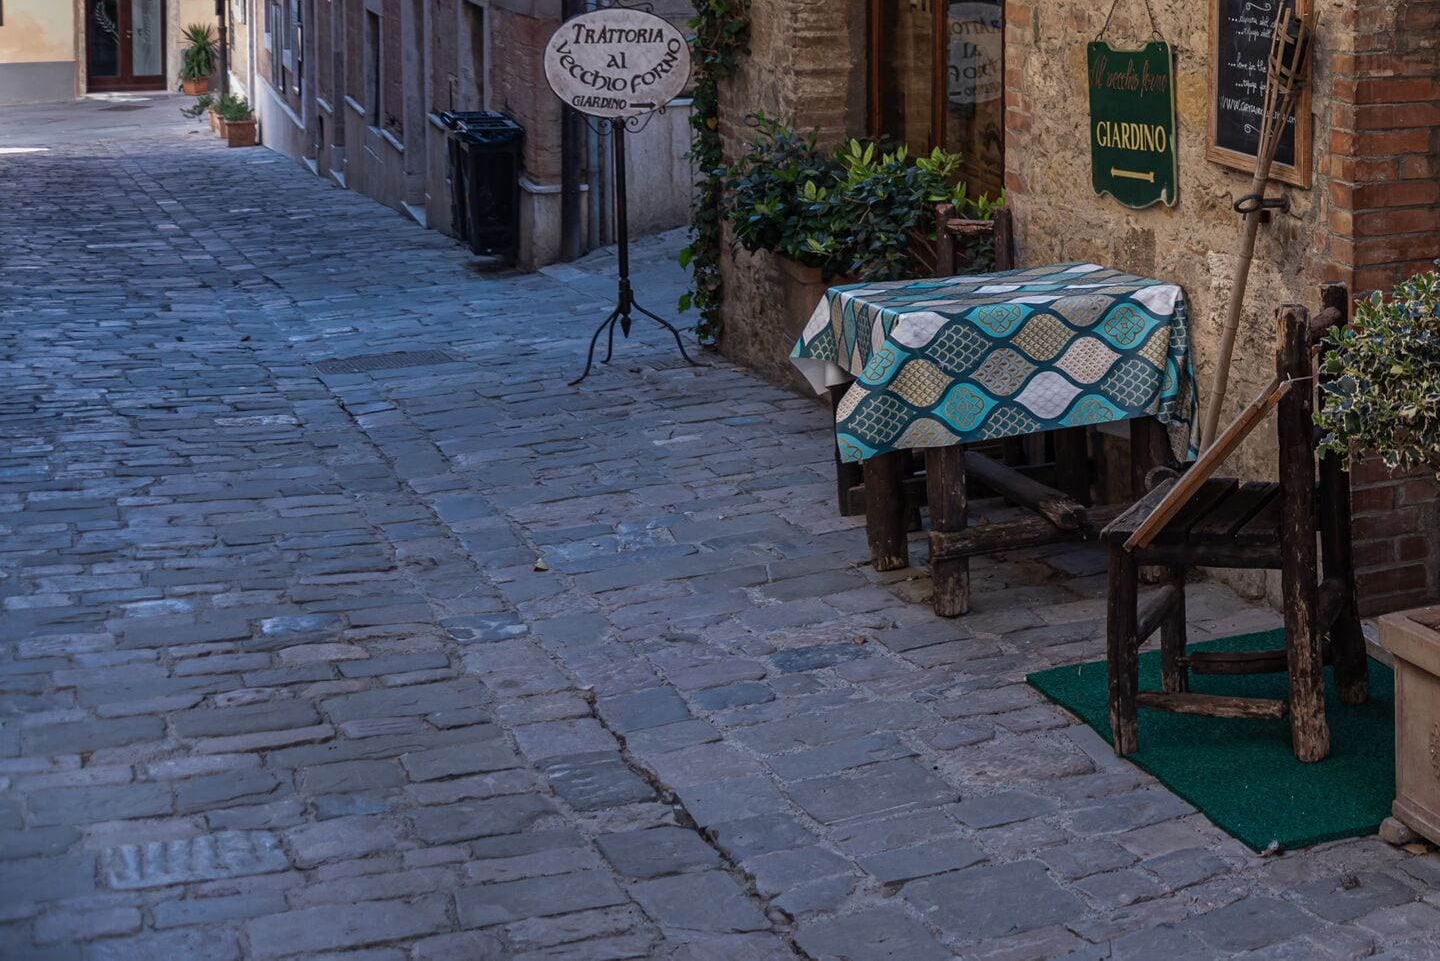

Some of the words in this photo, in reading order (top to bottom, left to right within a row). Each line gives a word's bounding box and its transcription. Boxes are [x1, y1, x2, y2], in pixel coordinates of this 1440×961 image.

[572, 23, 664, 44] TRATTORIA
[571, 95, 627, 110] GIARDINO
[1096, 121, 1167, 154] GIARDINO
